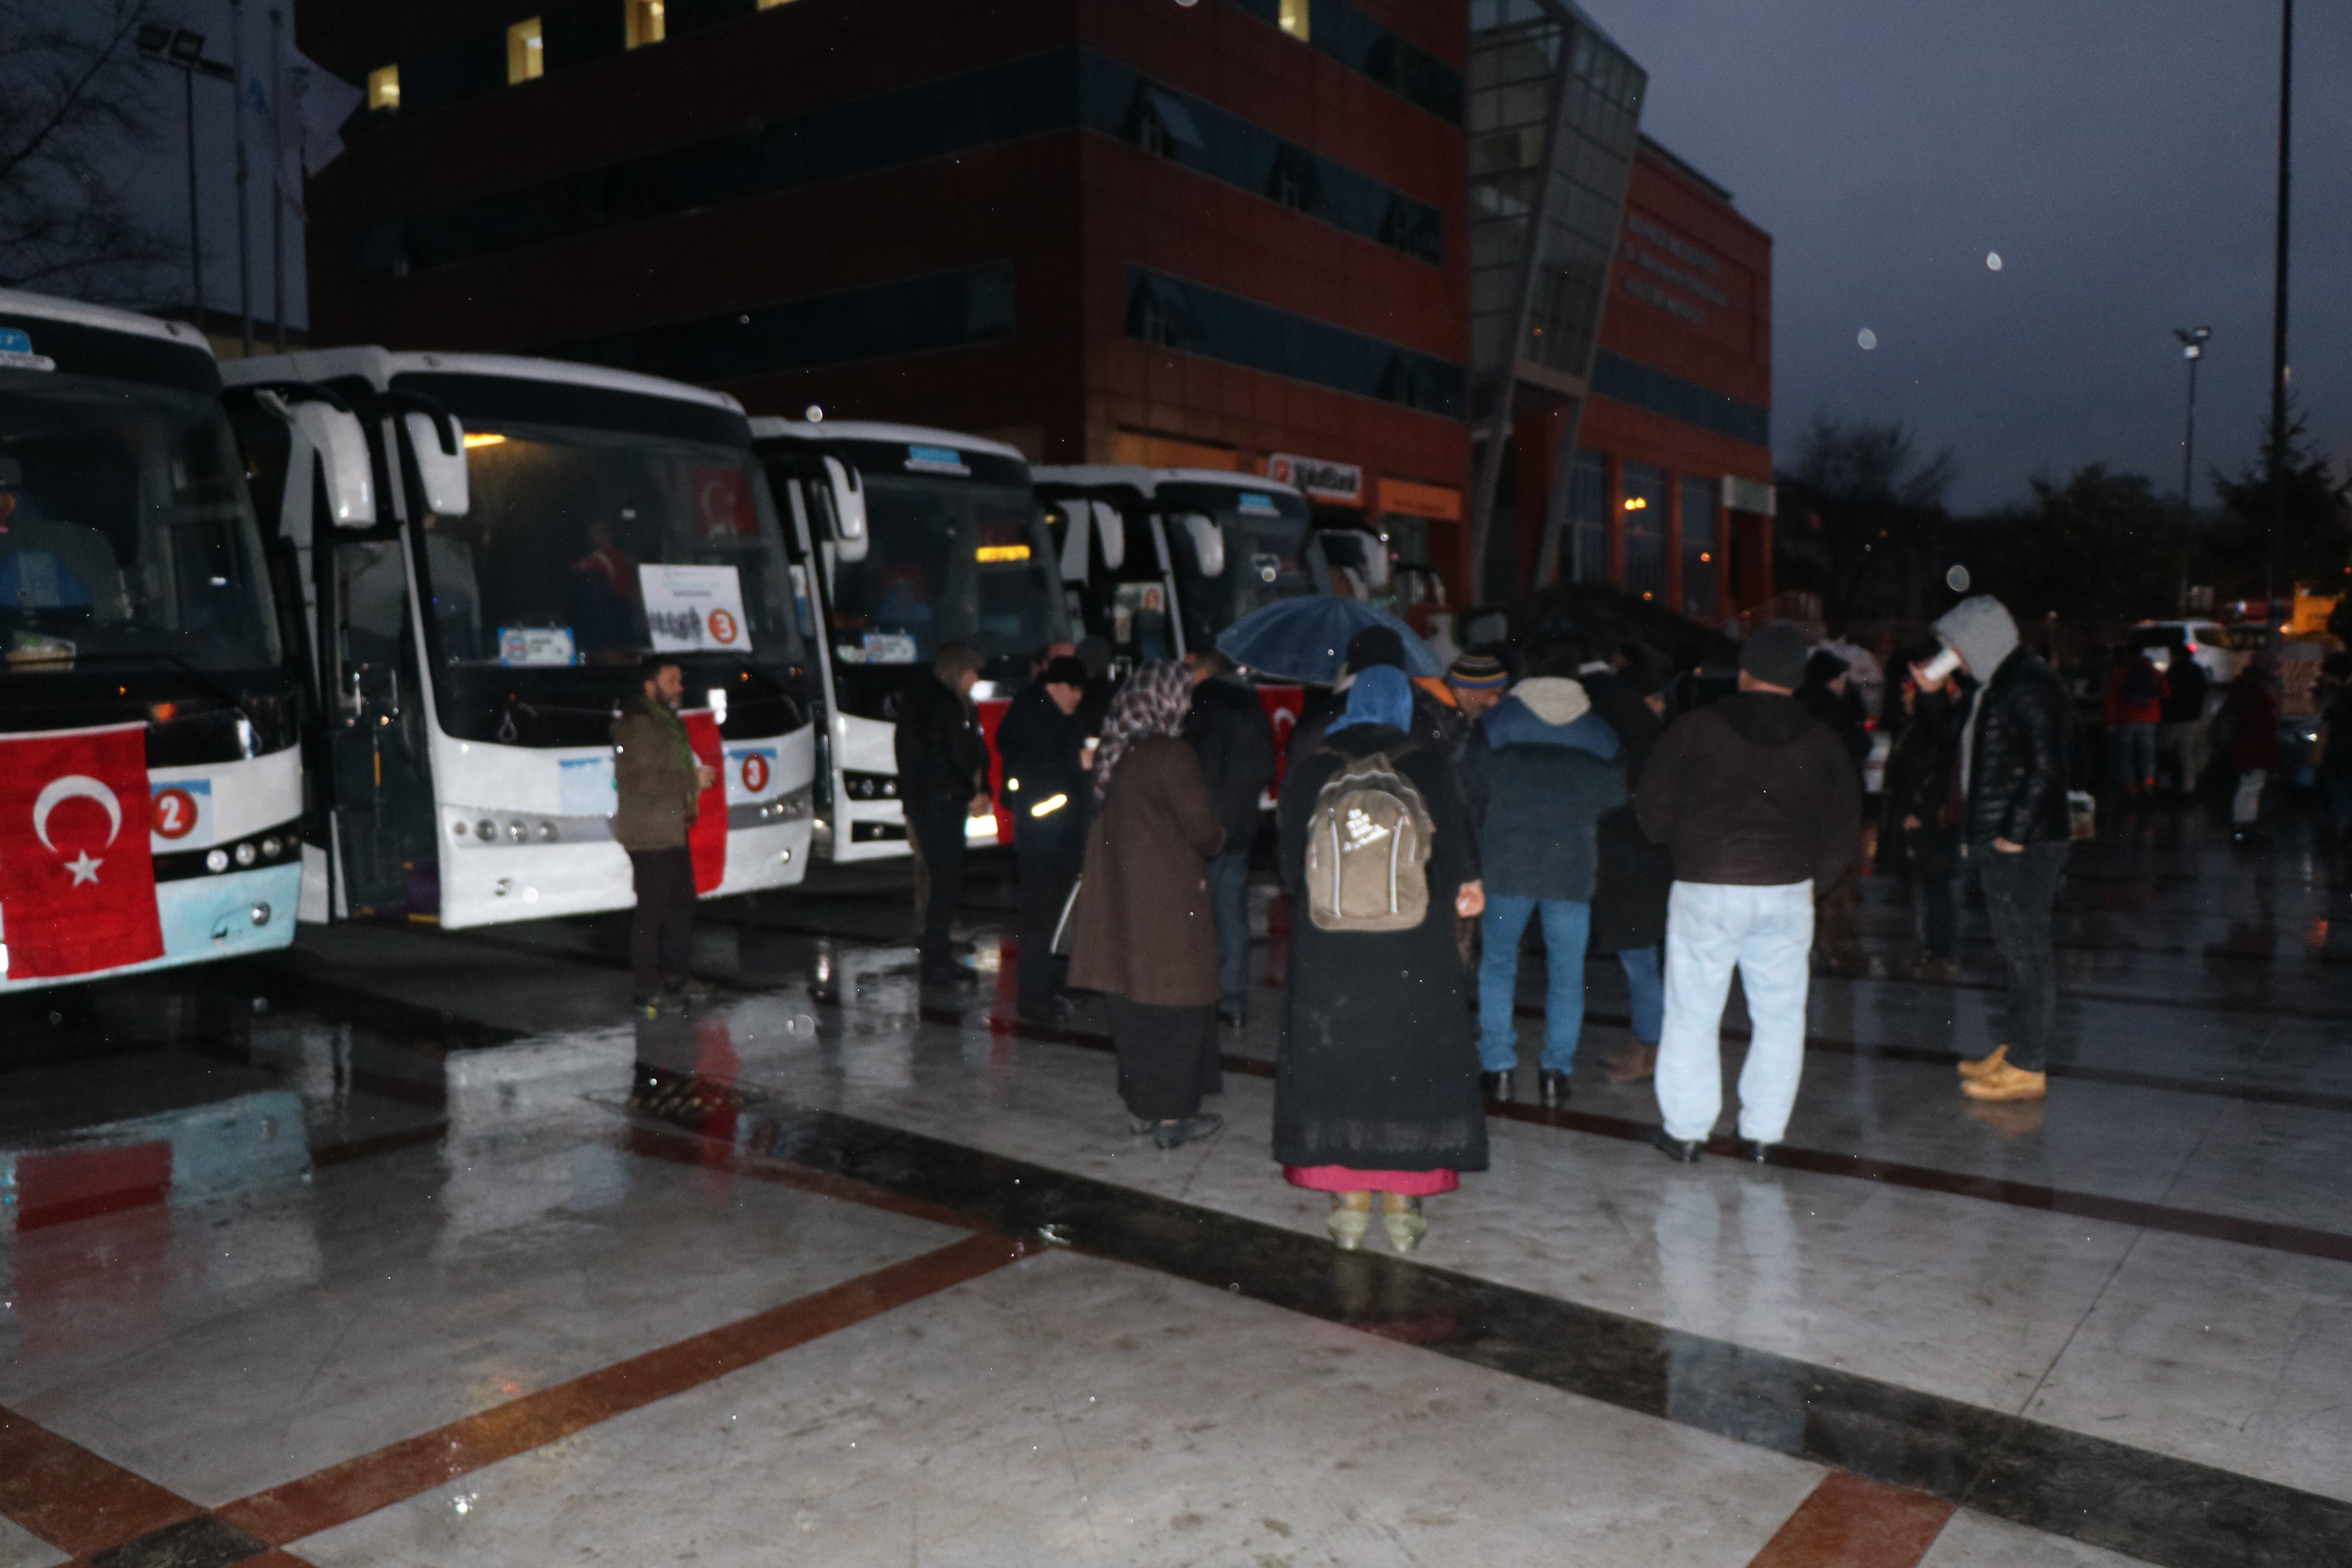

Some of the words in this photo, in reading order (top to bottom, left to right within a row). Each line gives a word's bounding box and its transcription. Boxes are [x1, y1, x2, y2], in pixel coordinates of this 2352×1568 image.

[715, 614, 733, 639] 3
[748, 759, 761, 786] 3
[160, 795, 182, 832] 2
